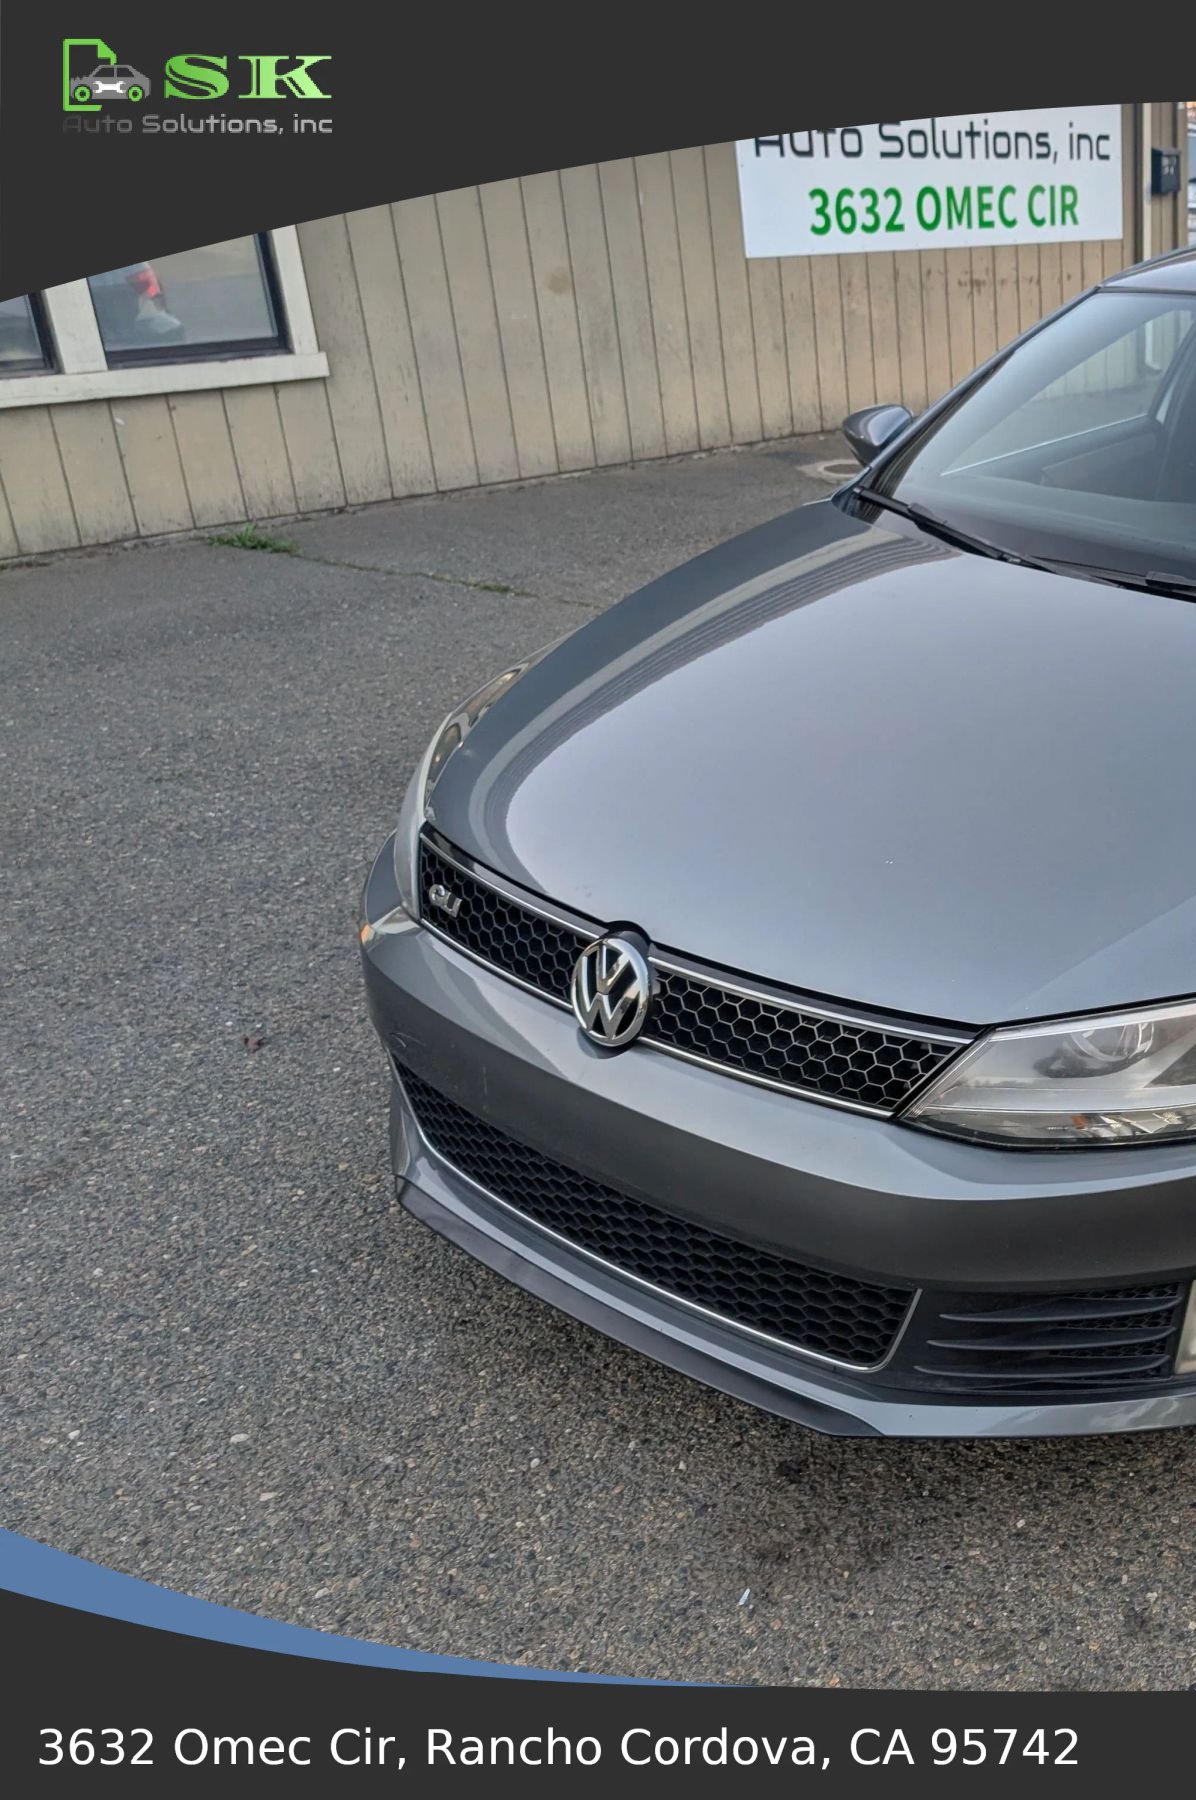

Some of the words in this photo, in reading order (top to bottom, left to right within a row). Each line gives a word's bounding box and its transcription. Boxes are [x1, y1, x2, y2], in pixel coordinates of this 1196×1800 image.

[754, 127, 863, 159] Auto
[878, 118, 1058, 164] Solutions,
[1068, 122, 1112, 161] inc
[808, 187, 905, 236] 3632
[916, 184, 1018, 232] OMEC
[1027, 184, 1080, 228] CIR
